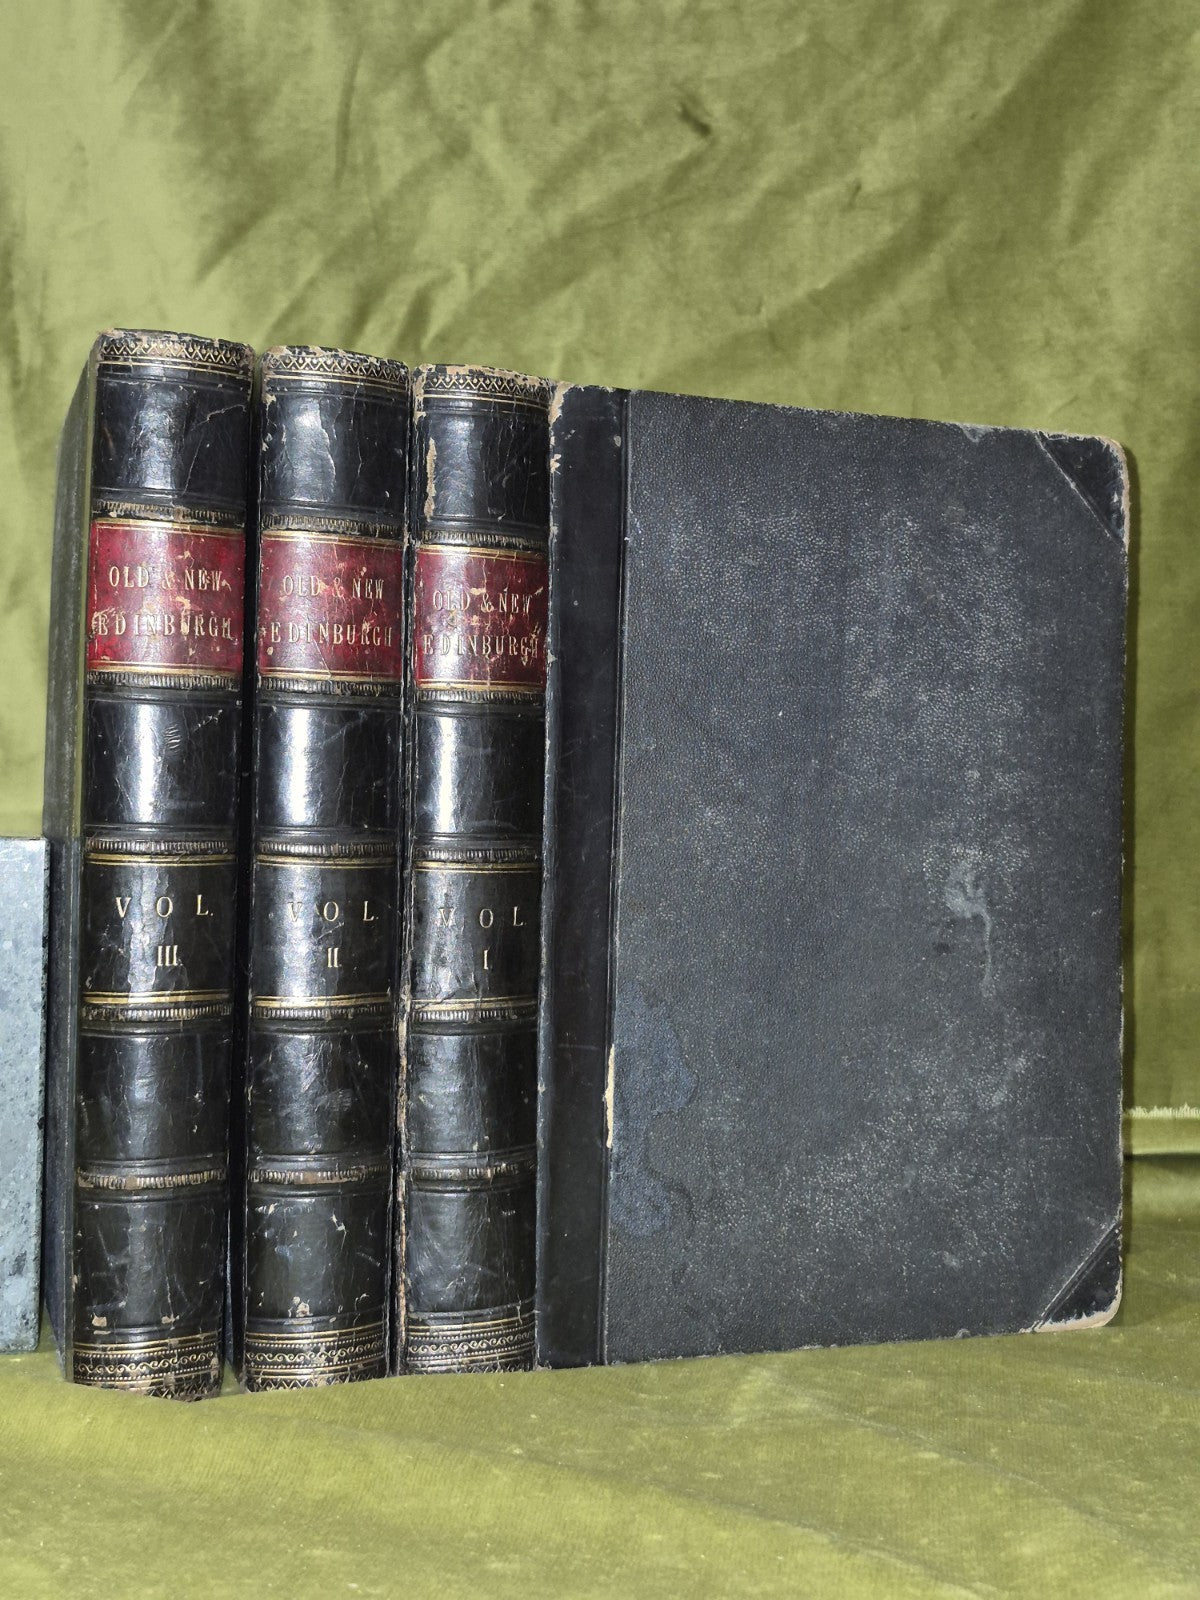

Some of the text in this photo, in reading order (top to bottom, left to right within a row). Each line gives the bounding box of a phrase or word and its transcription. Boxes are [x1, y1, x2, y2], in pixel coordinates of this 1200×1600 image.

[109, 566, 149, 588] OLD
[184, 569, 222, 591] NEW
[283, 575, 384, 600] OLD & NEW
[433, 590, 533, 614] OLD & NEW
[98, 613, 232, 639] EDINBURGH
[271, 621, 393, 647] EDINBURGH
